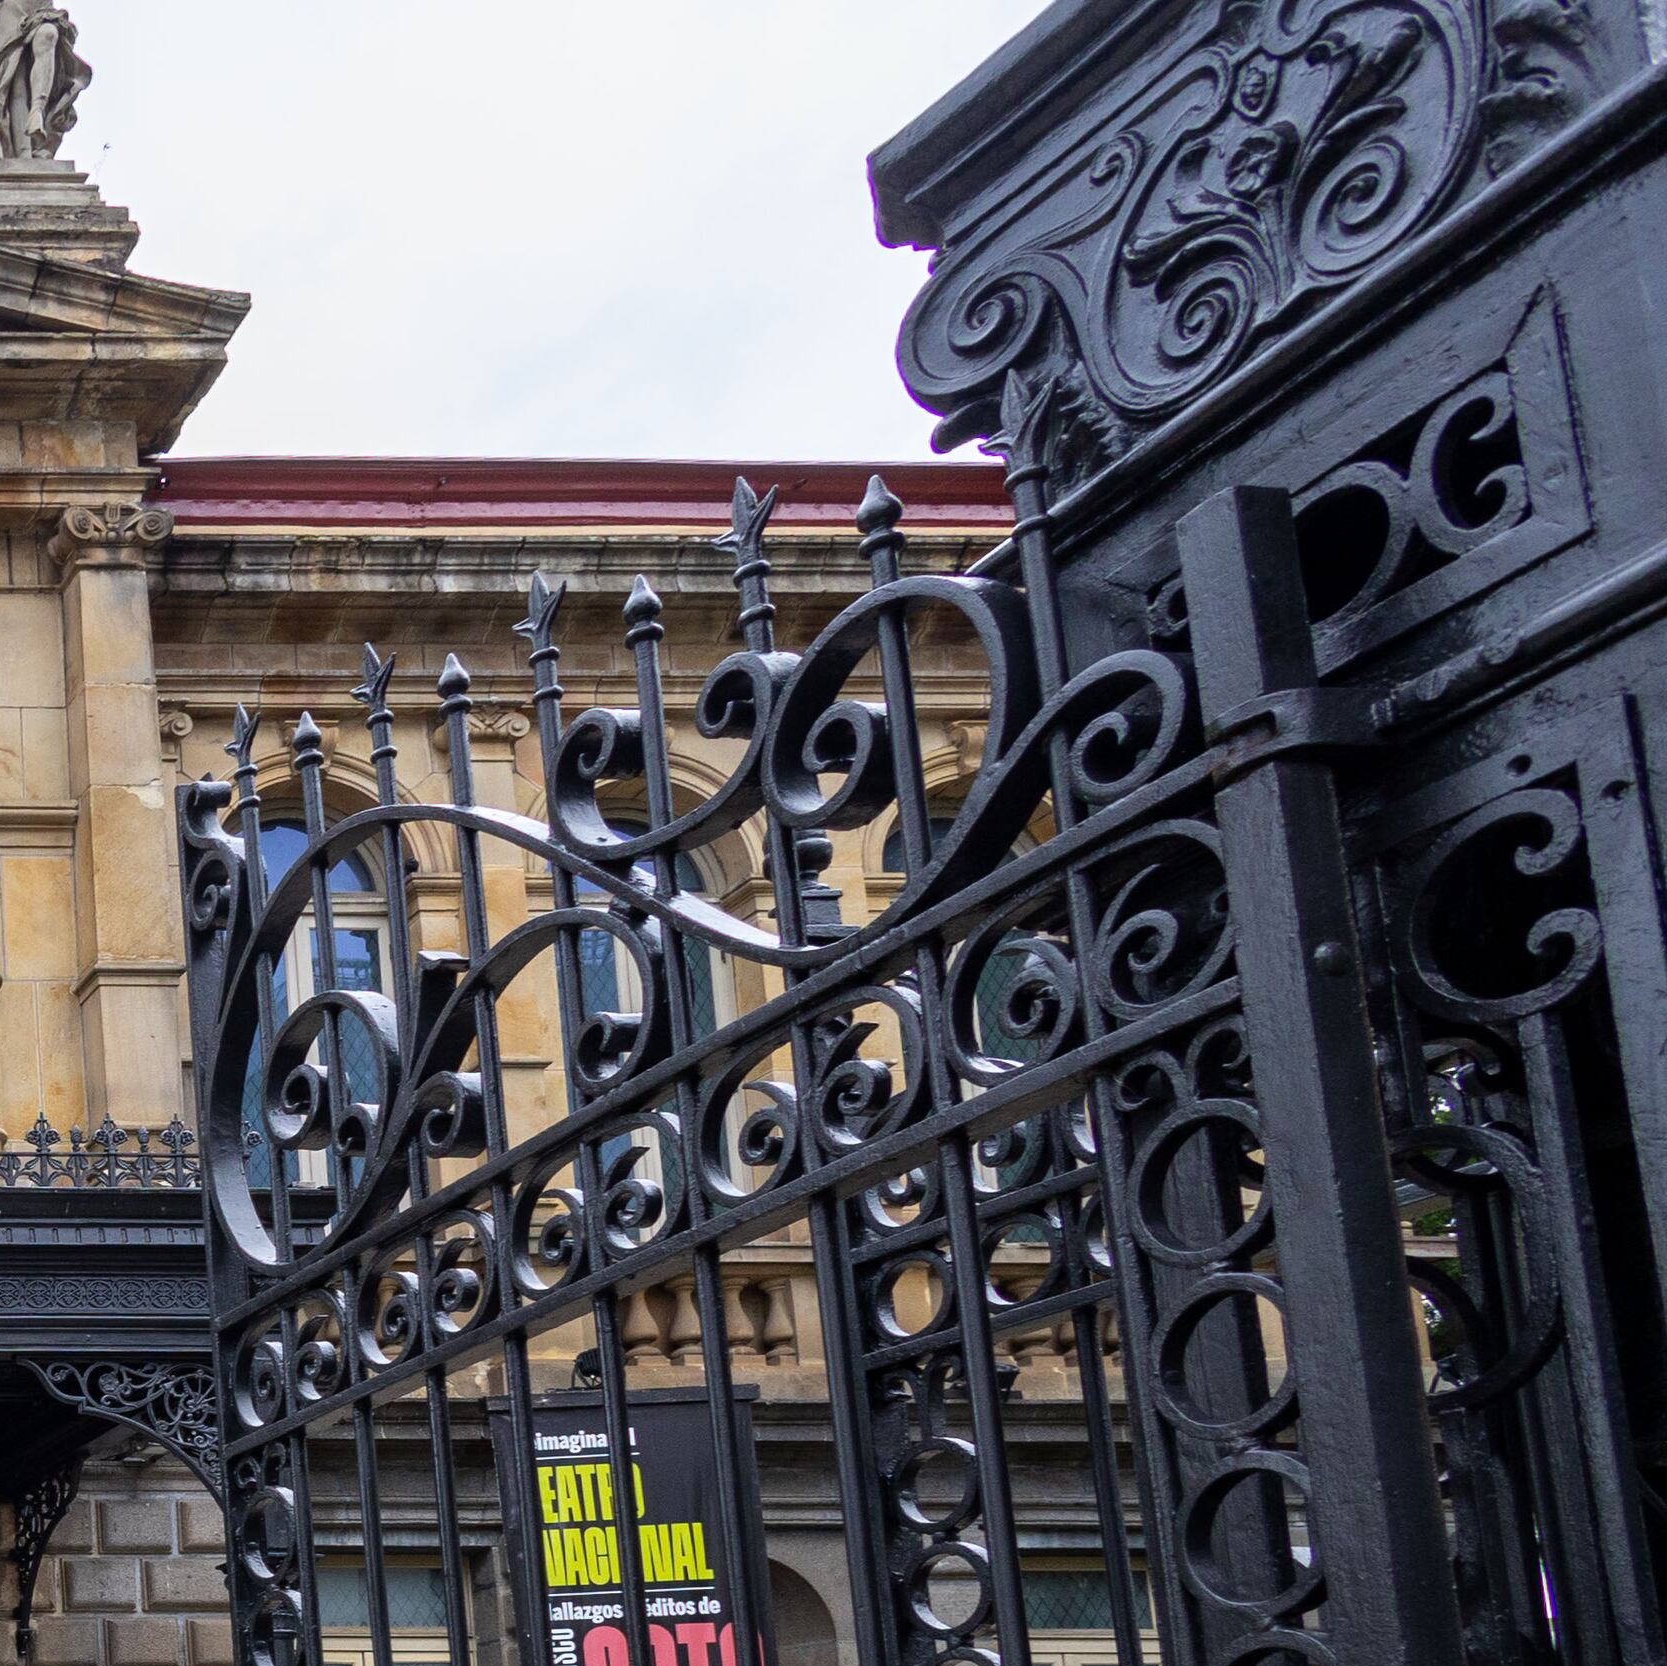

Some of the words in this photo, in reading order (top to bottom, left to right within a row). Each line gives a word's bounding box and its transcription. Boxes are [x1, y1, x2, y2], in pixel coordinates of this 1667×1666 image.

[534, 1430, 608, 1454] imagina
[542, 1522, 715, 1587] NACINAL
[549, 1601, 624, 1624] allazgos
[698, 1596, 721, 1615] de
